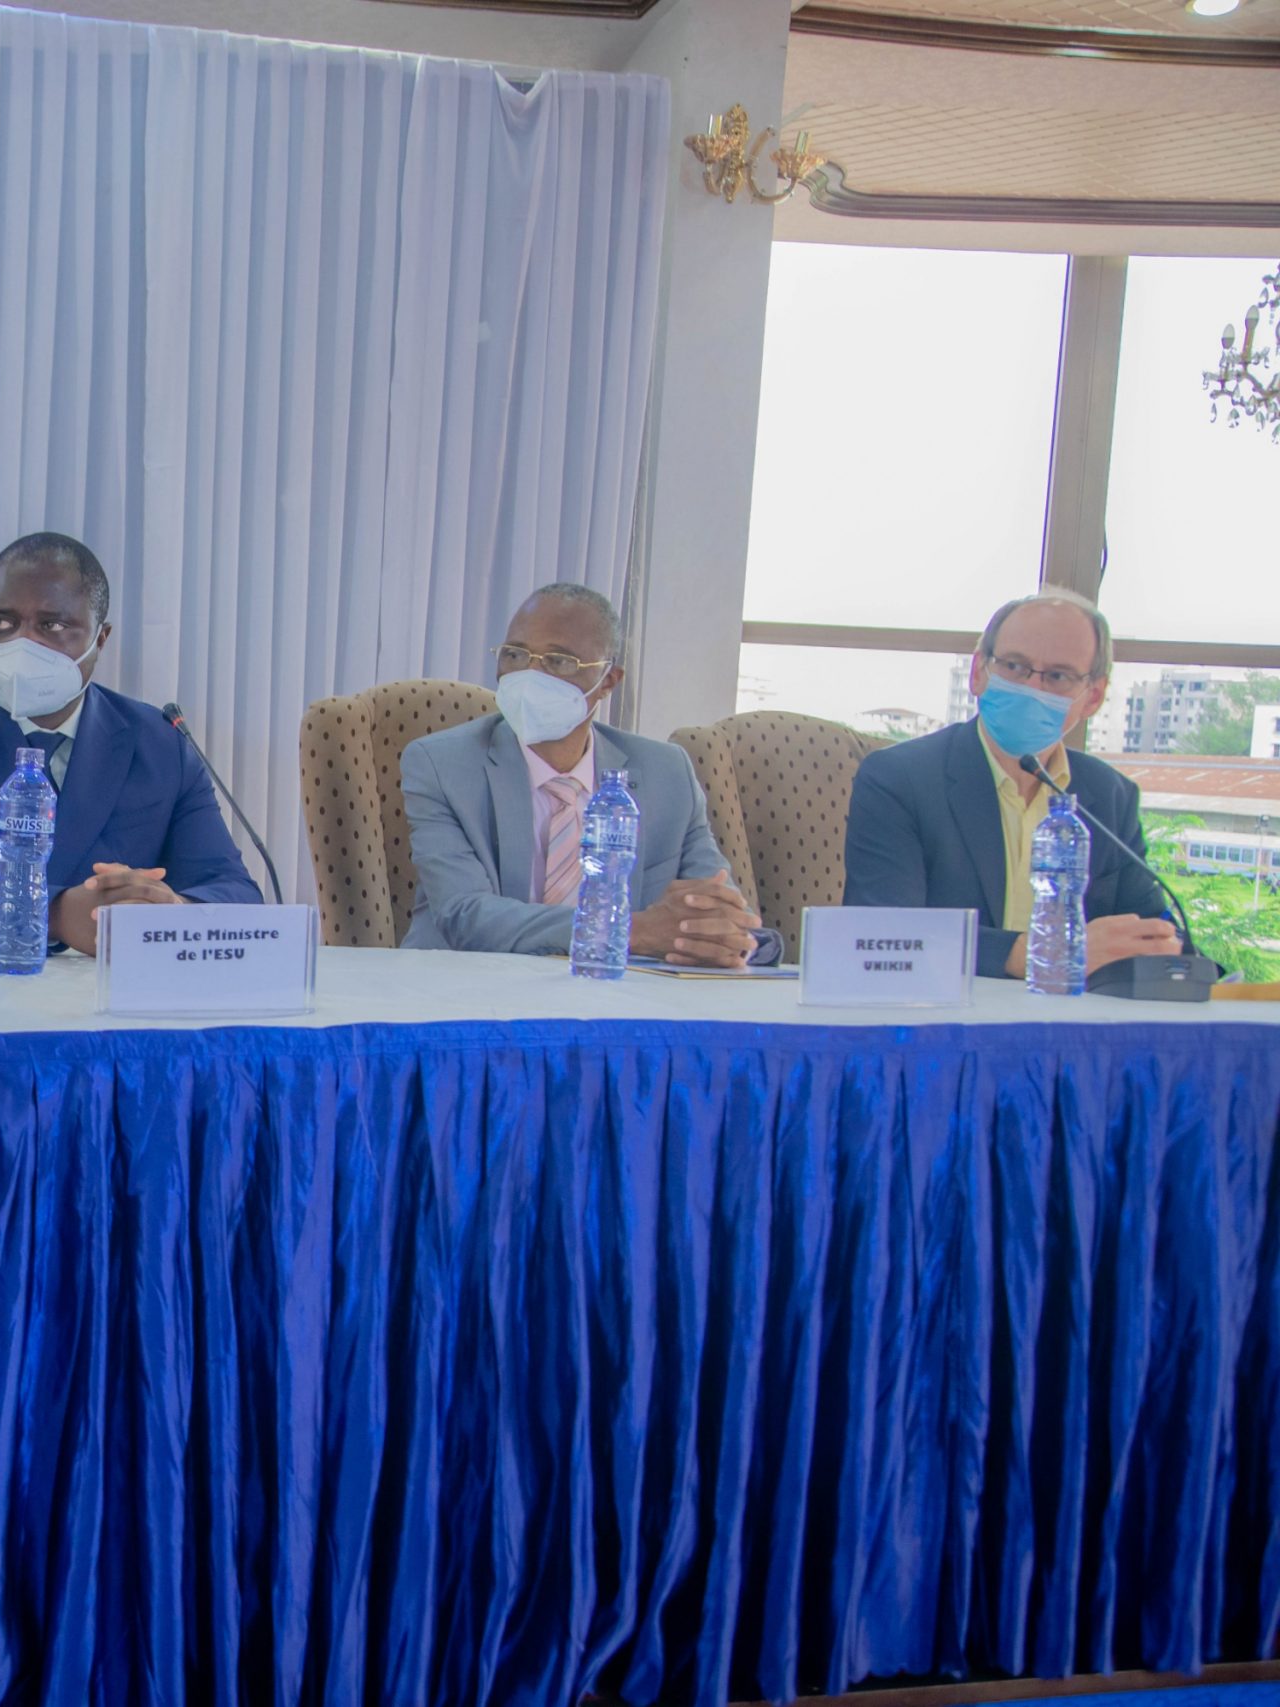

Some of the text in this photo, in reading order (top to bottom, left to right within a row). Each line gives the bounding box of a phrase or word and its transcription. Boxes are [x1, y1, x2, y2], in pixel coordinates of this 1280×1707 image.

[143, 928, 279, 943] SEM Le Ministre
[856, 939, 924, 951] RECTEUR
[176, 948, 245, 961] de l'ESU
[864, 961, 913, 971] UNIKIN
